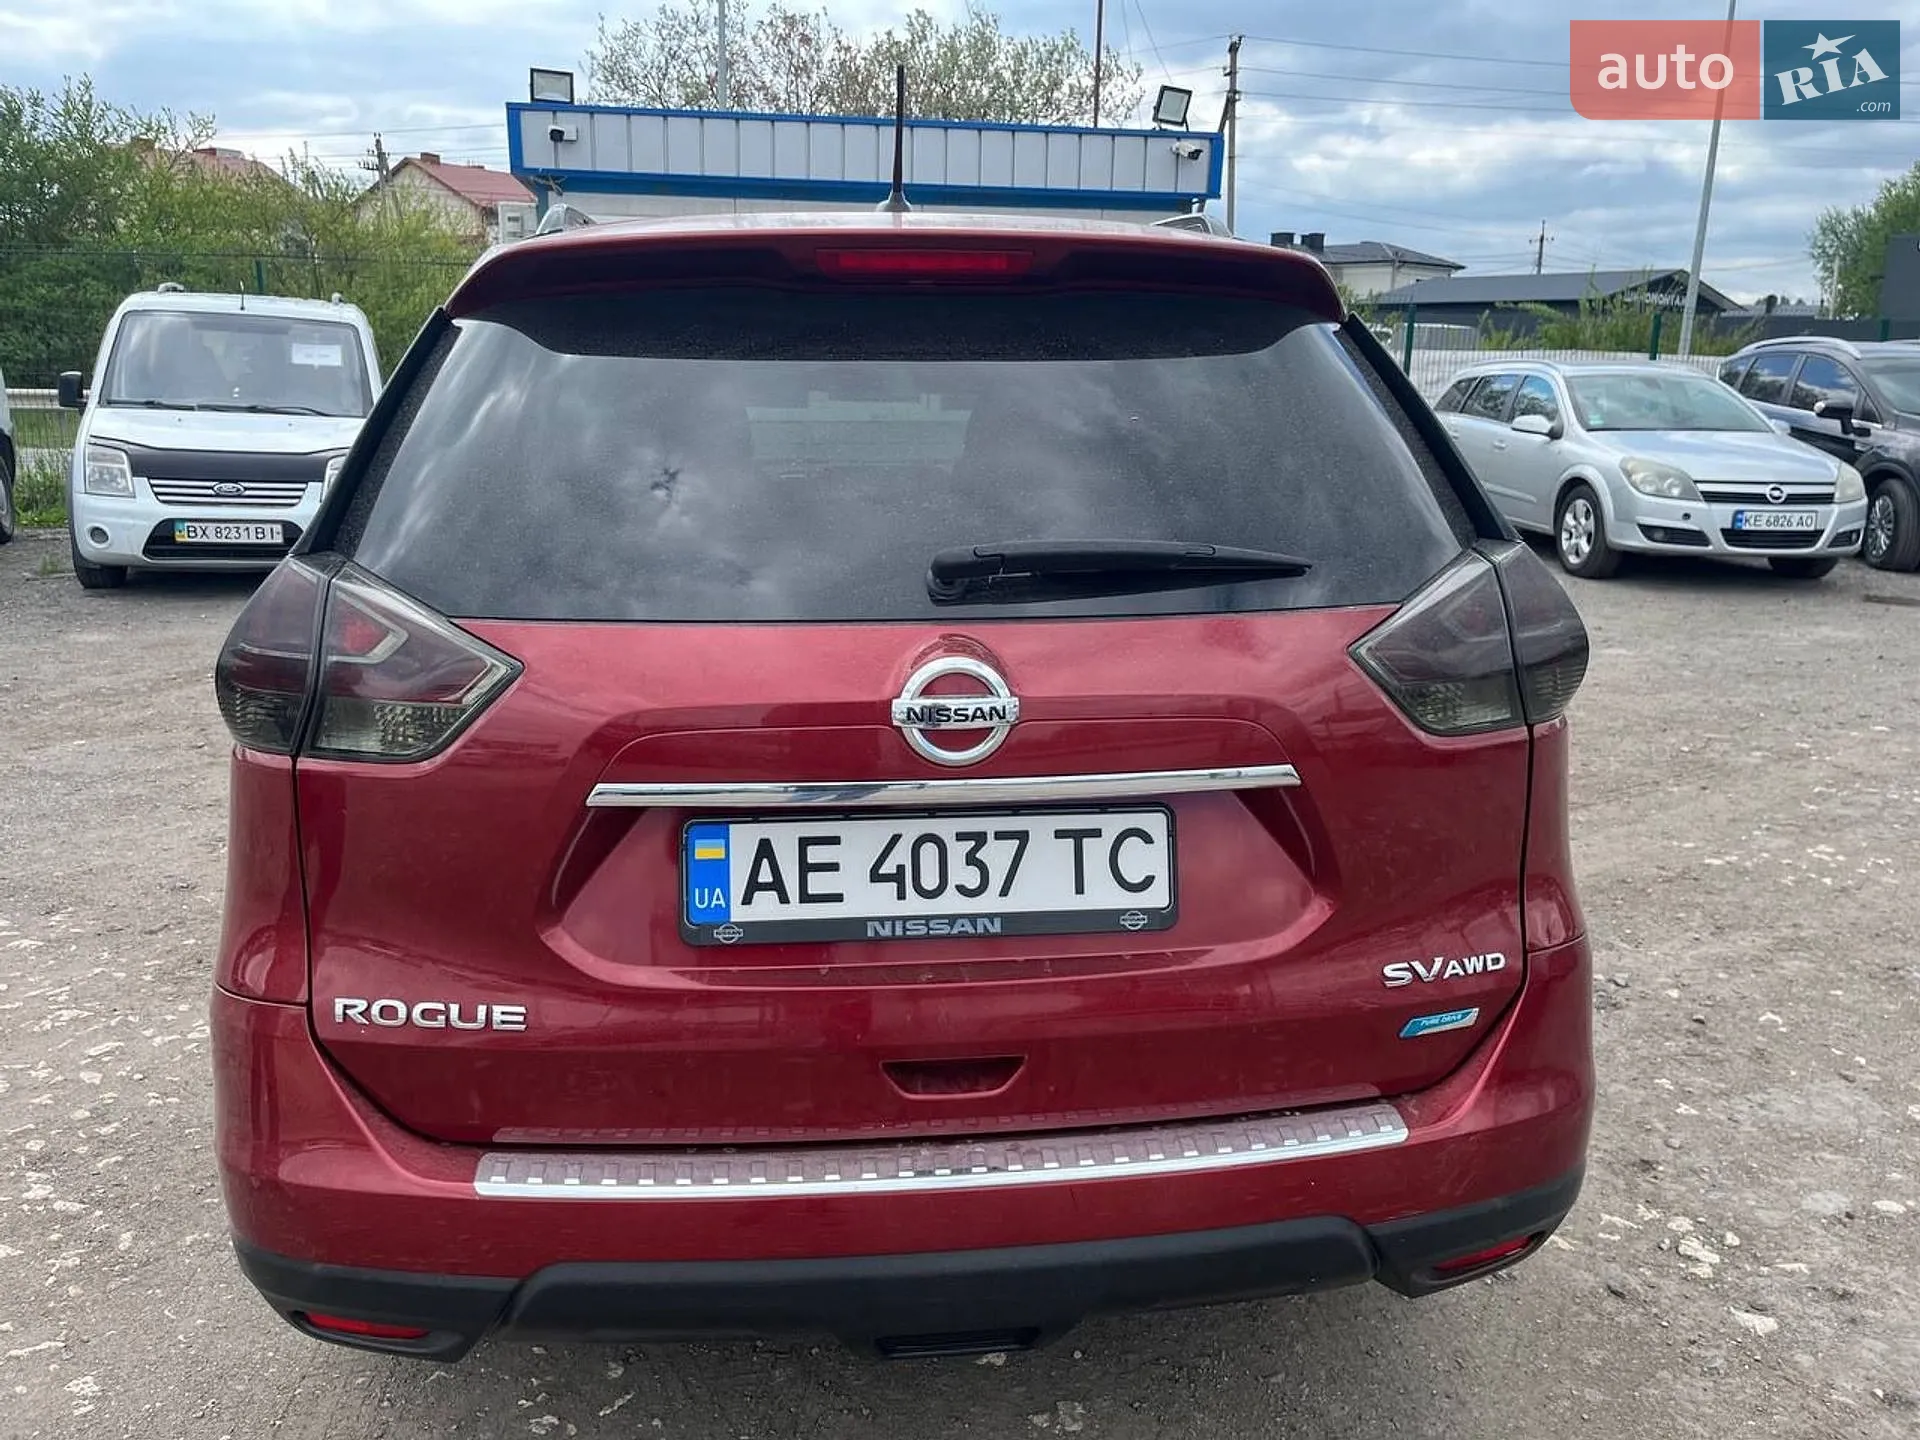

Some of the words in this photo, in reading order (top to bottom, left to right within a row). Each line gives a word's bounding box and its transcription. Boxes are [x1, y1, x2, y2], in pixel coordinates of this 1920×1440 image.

[1744, 514, 1763, 527] KE
[1765, 514, 1794, 528] 6826
[186, 525, 209, 539] BX
[214, 526, 251, 540] 8231
[905, 705, 1009, 724] NISSAN
[741, 836, 845, 906] AE
[869, 829, 1030, 902] 4037
[1054, 827, 1156, 895] TC
[695, 888, 726, 909] UA
[866, 917, 1002, 938] NISSAN
[333, 997, 529, 1032] ROGUE
